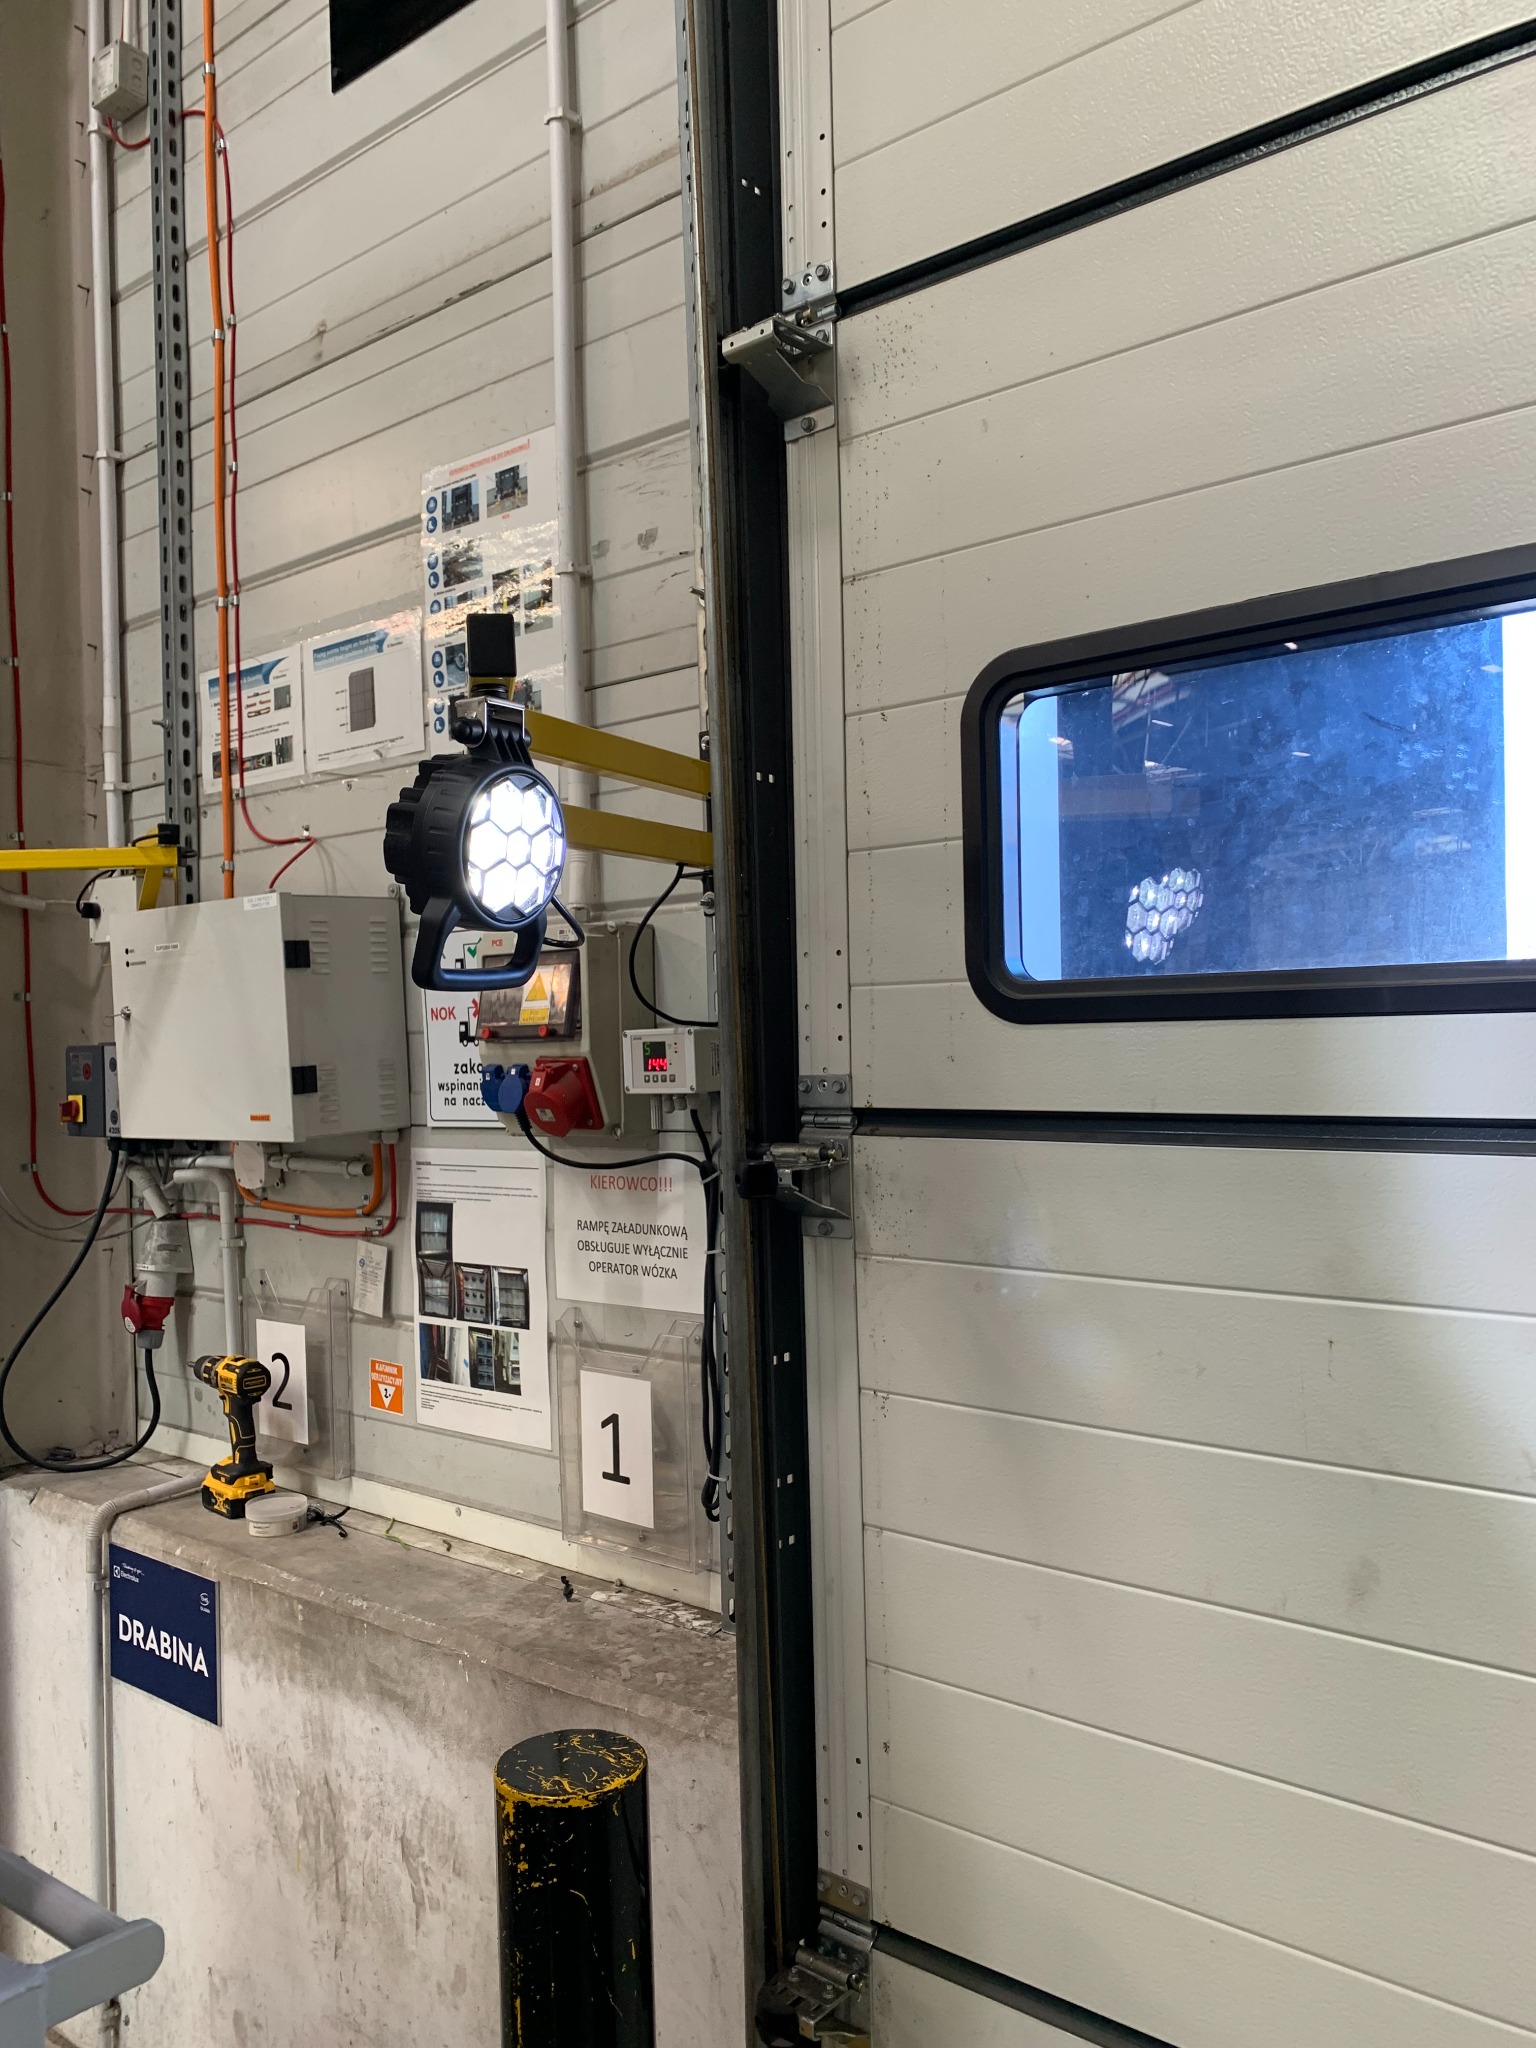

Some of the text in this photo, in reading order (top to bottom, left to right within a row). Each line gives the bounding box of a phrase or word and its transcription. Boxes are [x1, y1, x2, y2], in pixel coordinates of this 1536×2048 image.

[430, 1006, 456, 1021] NOK
[437, 1078, 483, 1095] wspinani
[444, 1095, 457, 1106] na
[590, 1174, 672, 1192] KIEROWCO!!!
[577, 1219, 688, 1240] RAMPĘ ZAŁADUNKOWĄ
[577, 1239, 688, 1260] OBSŁUGUJE WYŁĄCZNIE
[588, 1260, 678, 1279] OPERATOR WÓZKA
[271, 1352, 292, 1410] 2
[600, 1412, 631, 1485] 1
[118, 1612, 209, 1678] DRABINA
